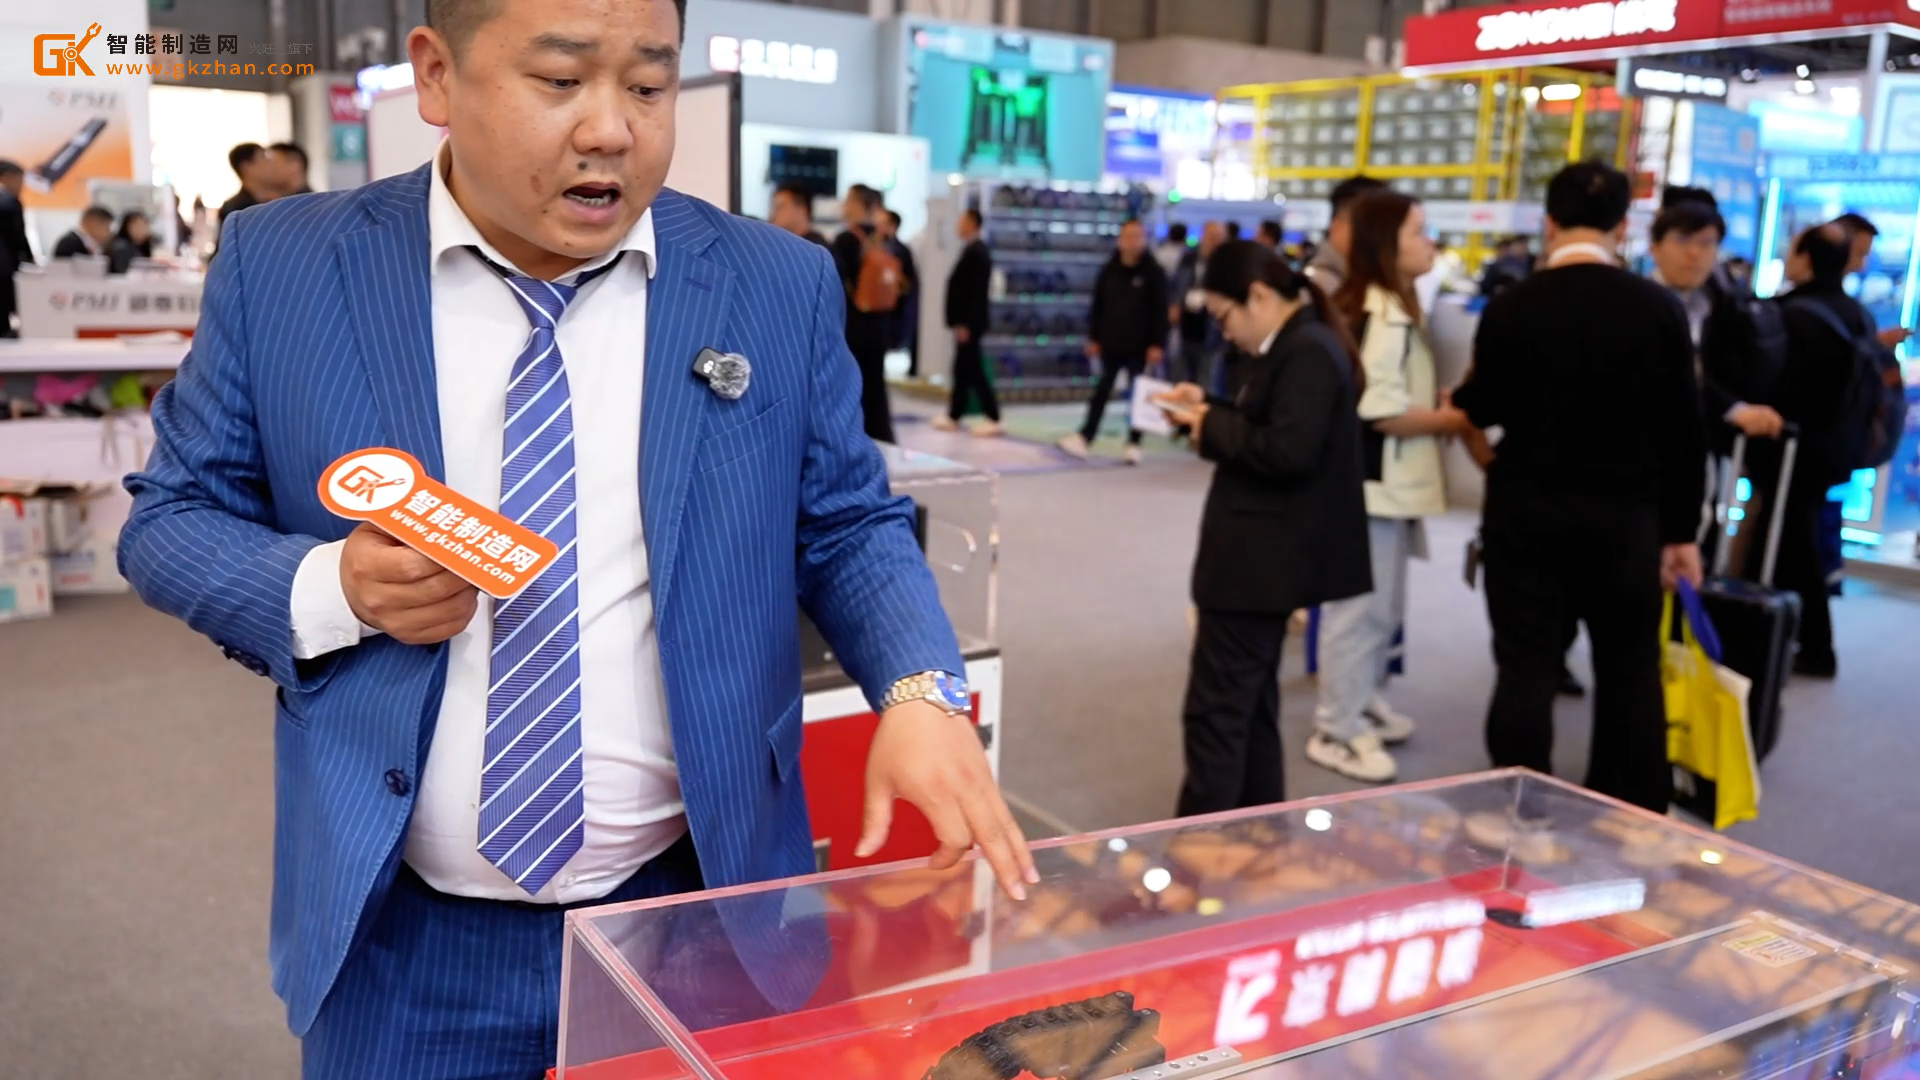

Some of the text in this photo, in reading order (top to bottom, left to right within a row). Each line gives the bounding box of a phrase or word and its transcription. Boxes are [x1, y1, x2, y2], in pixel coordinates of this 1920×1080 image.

[337, 465, 406, 504] GK
[390, 509, 516, 585] www.gkzhan.com
[404, 489, 541, 573] 智能制造网
